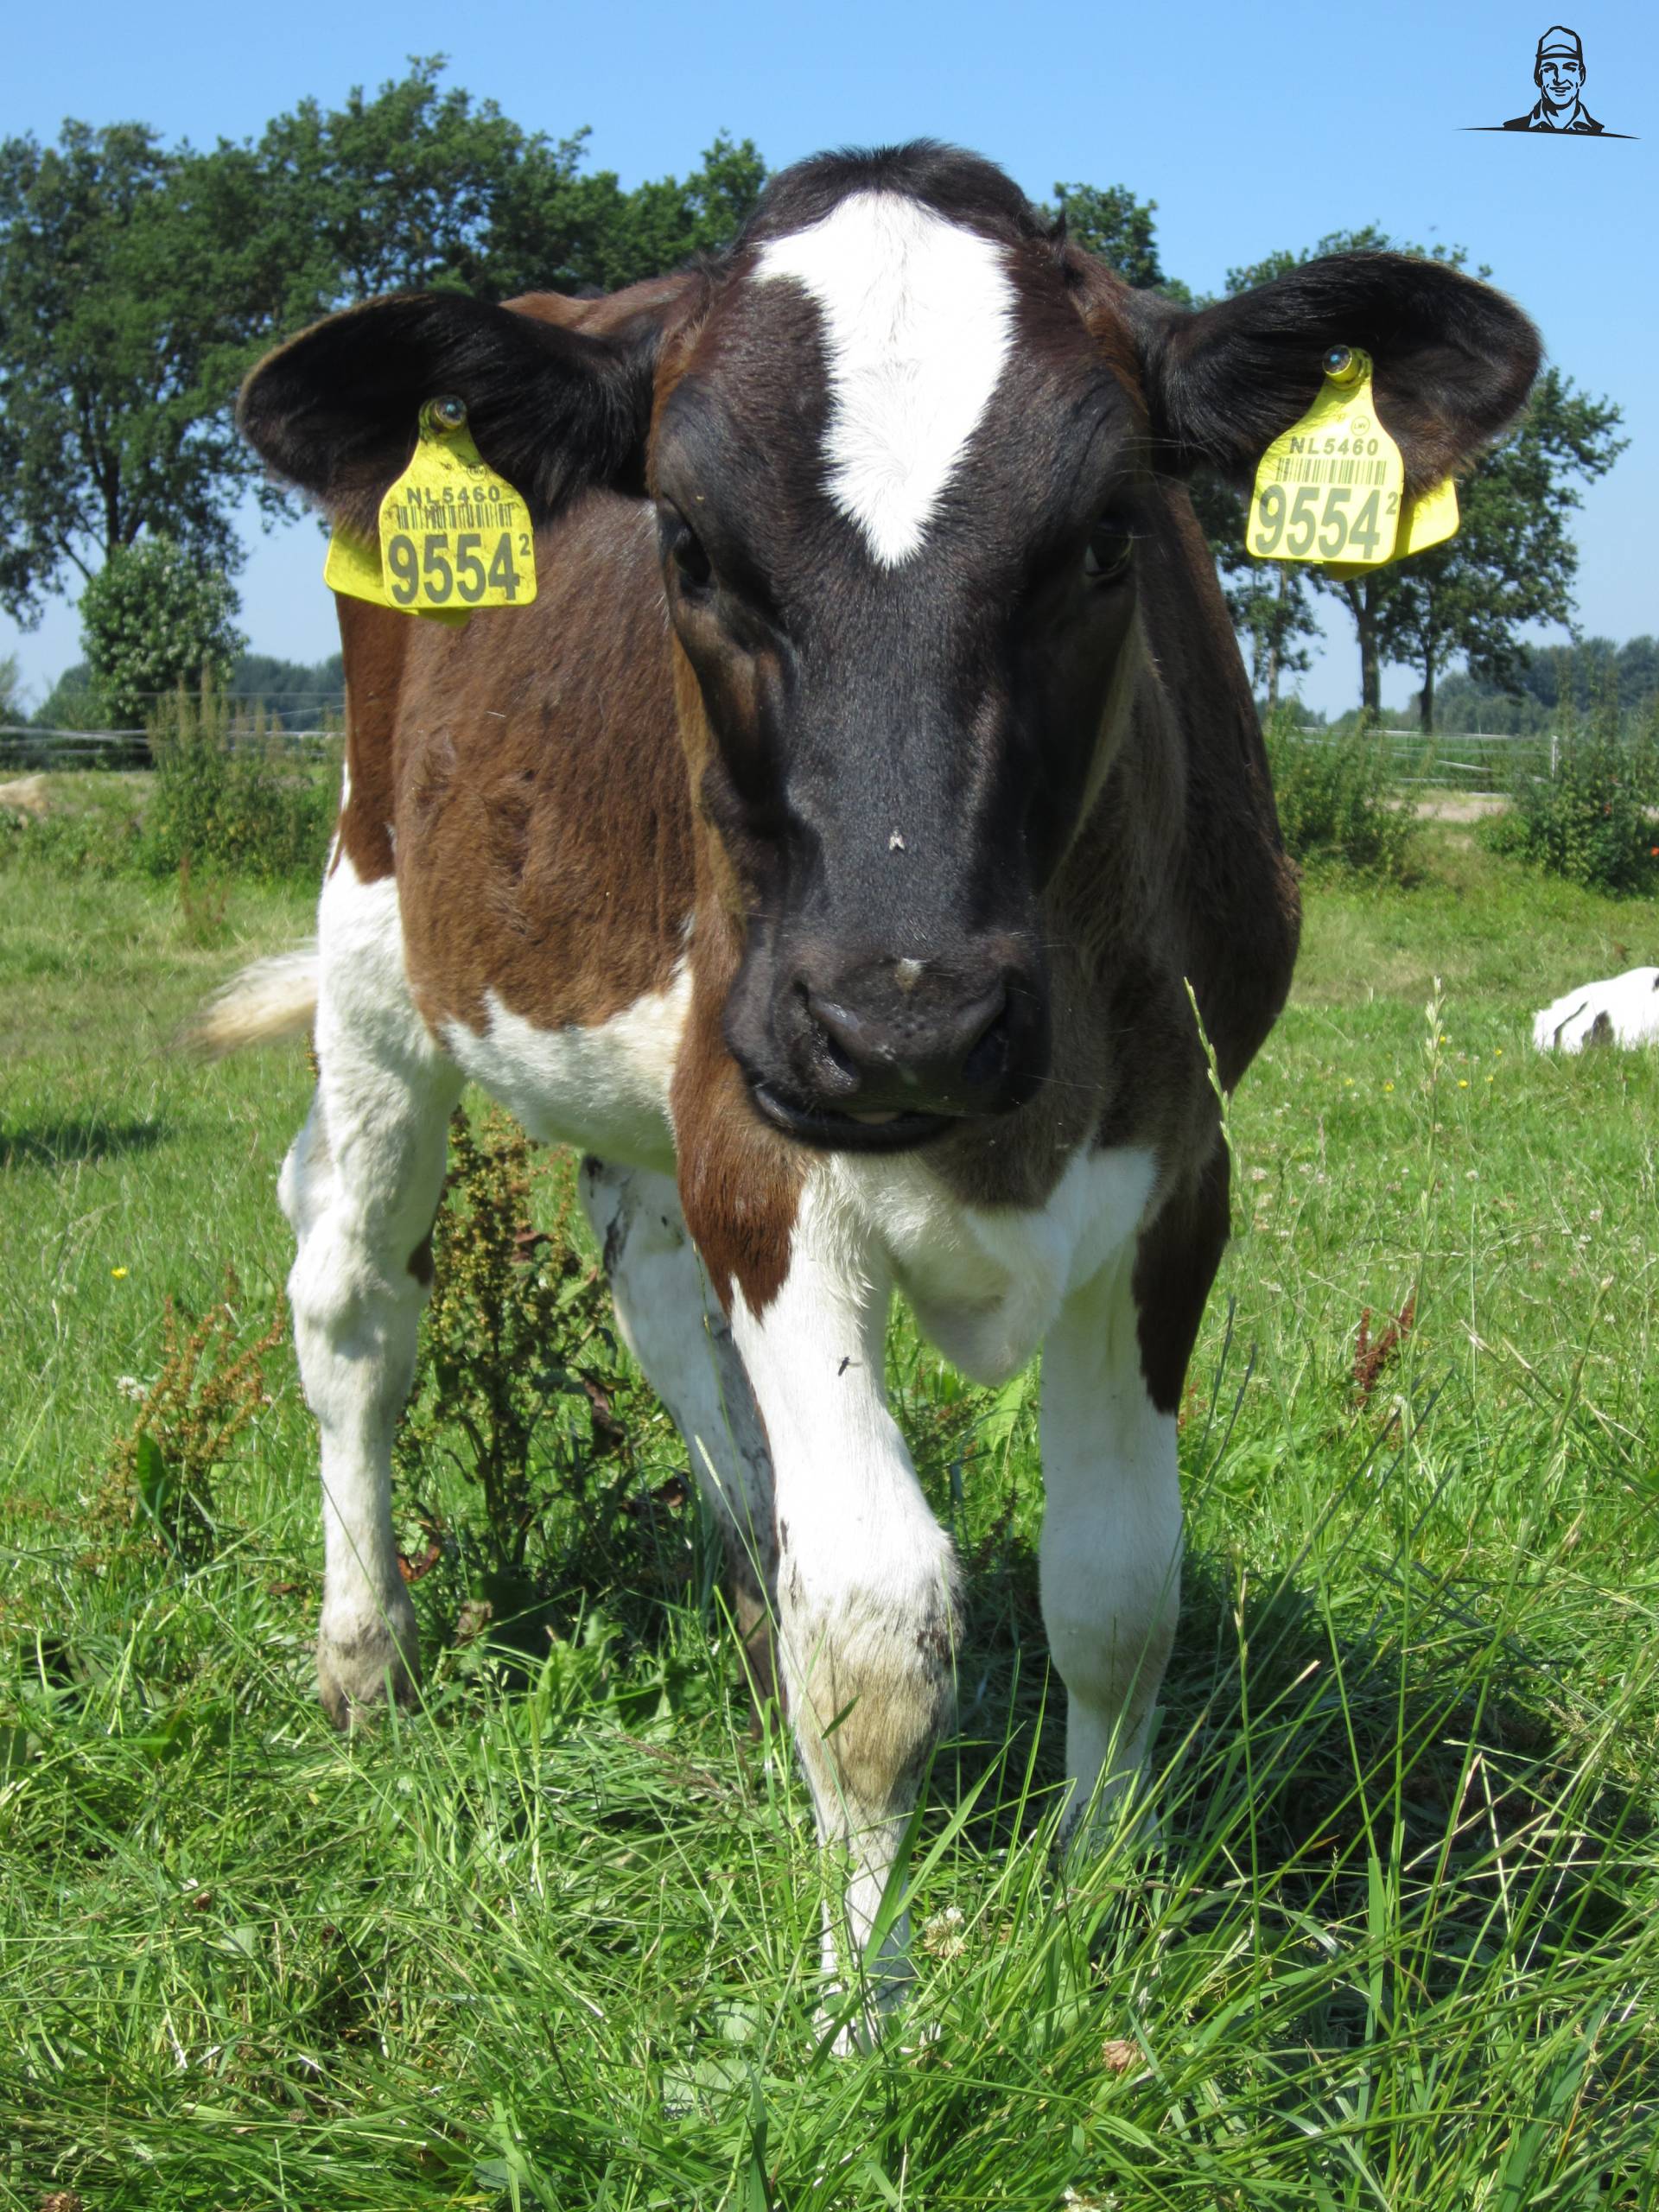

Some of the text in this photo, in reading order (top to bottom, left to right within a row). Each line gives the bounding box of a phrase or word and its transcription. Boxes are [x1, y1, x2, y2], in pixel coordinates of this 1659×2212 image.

[1255, 484, 1398, 560] 9554 2
[388, 532, 531, 605] 9554 2
